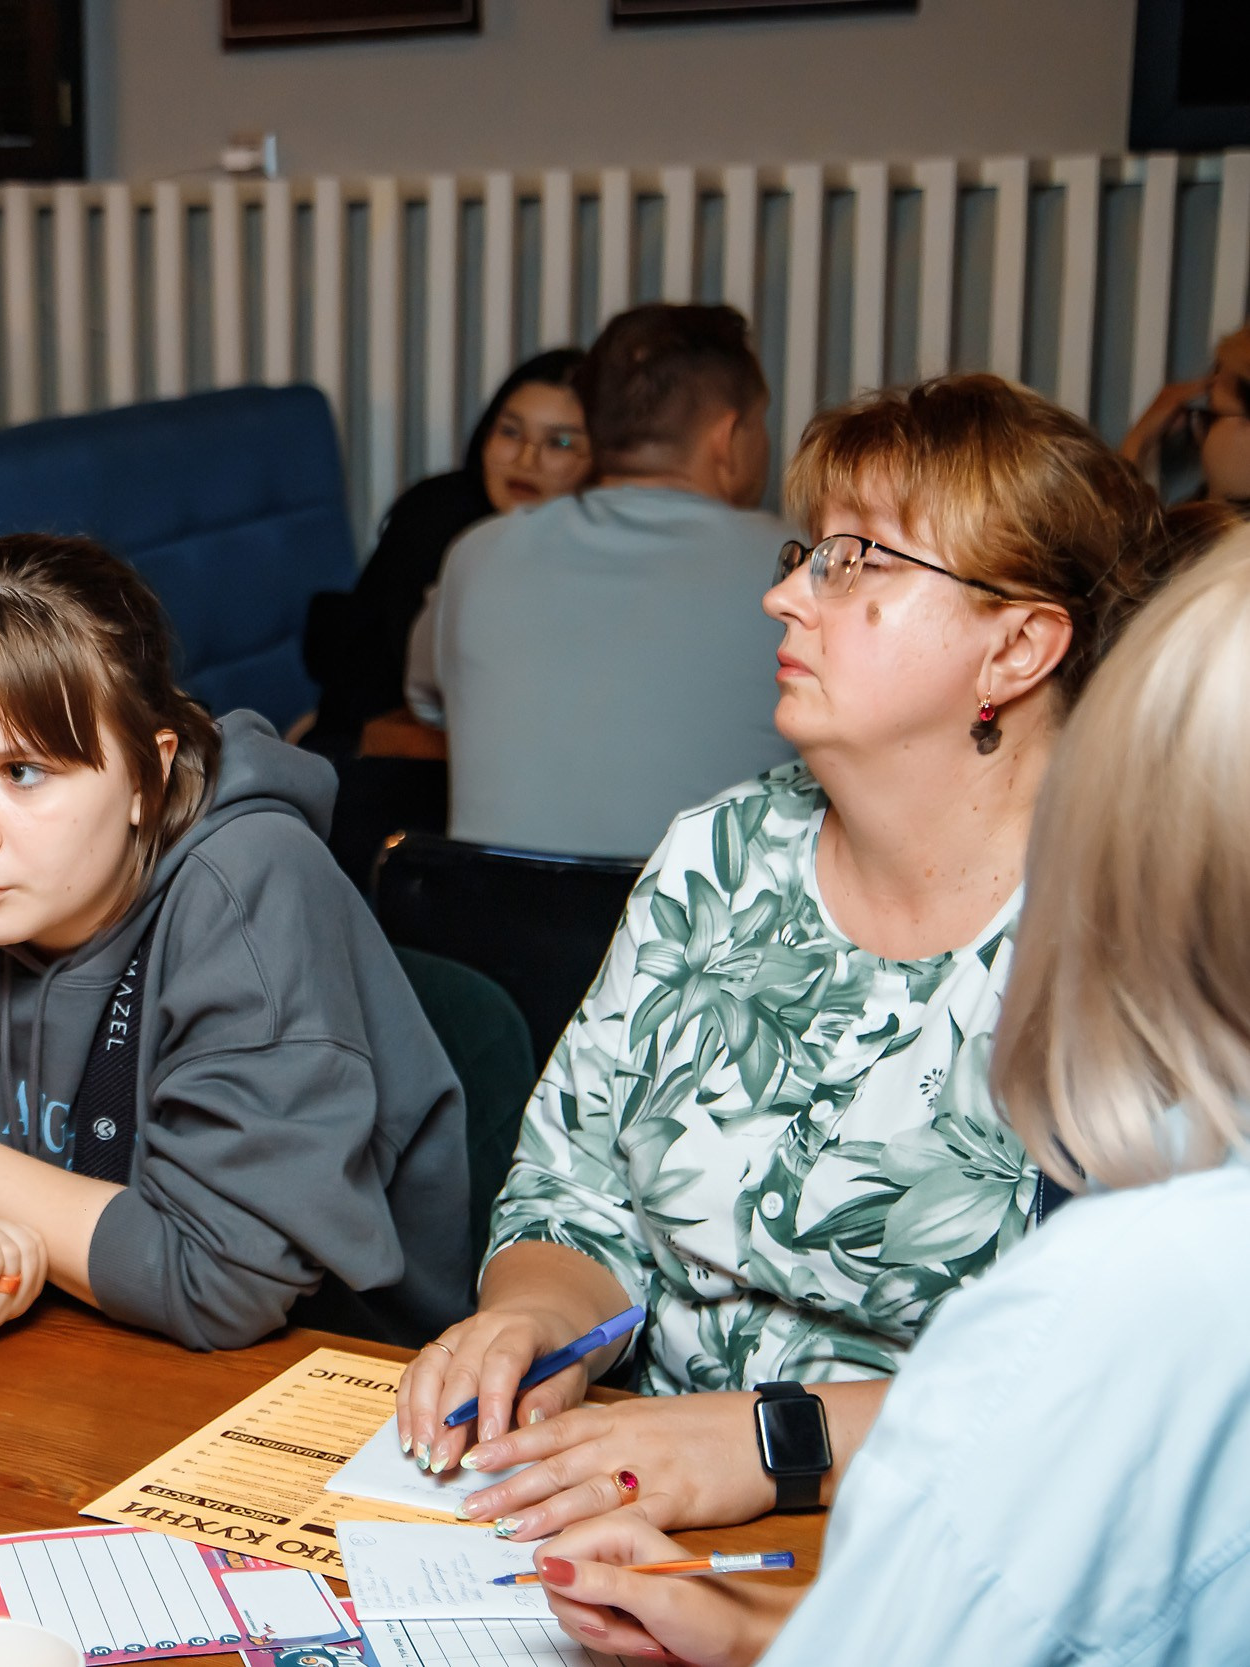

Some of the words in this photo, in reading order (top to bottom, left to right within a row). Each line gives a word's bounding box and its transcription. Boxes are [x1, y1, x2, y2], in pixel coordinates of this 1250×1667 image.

[106, 946, 141, 1052] MAZEL
[307, 1368, 399, 1394] UBLIC
[148, 1486, 200, 1504] ТЕСТЕ
[203, 1499, 229, 1512] НА
[118, 1500, 272, 1546] КУХНИ
[226, 1506, 281, 1525] МЯСО
